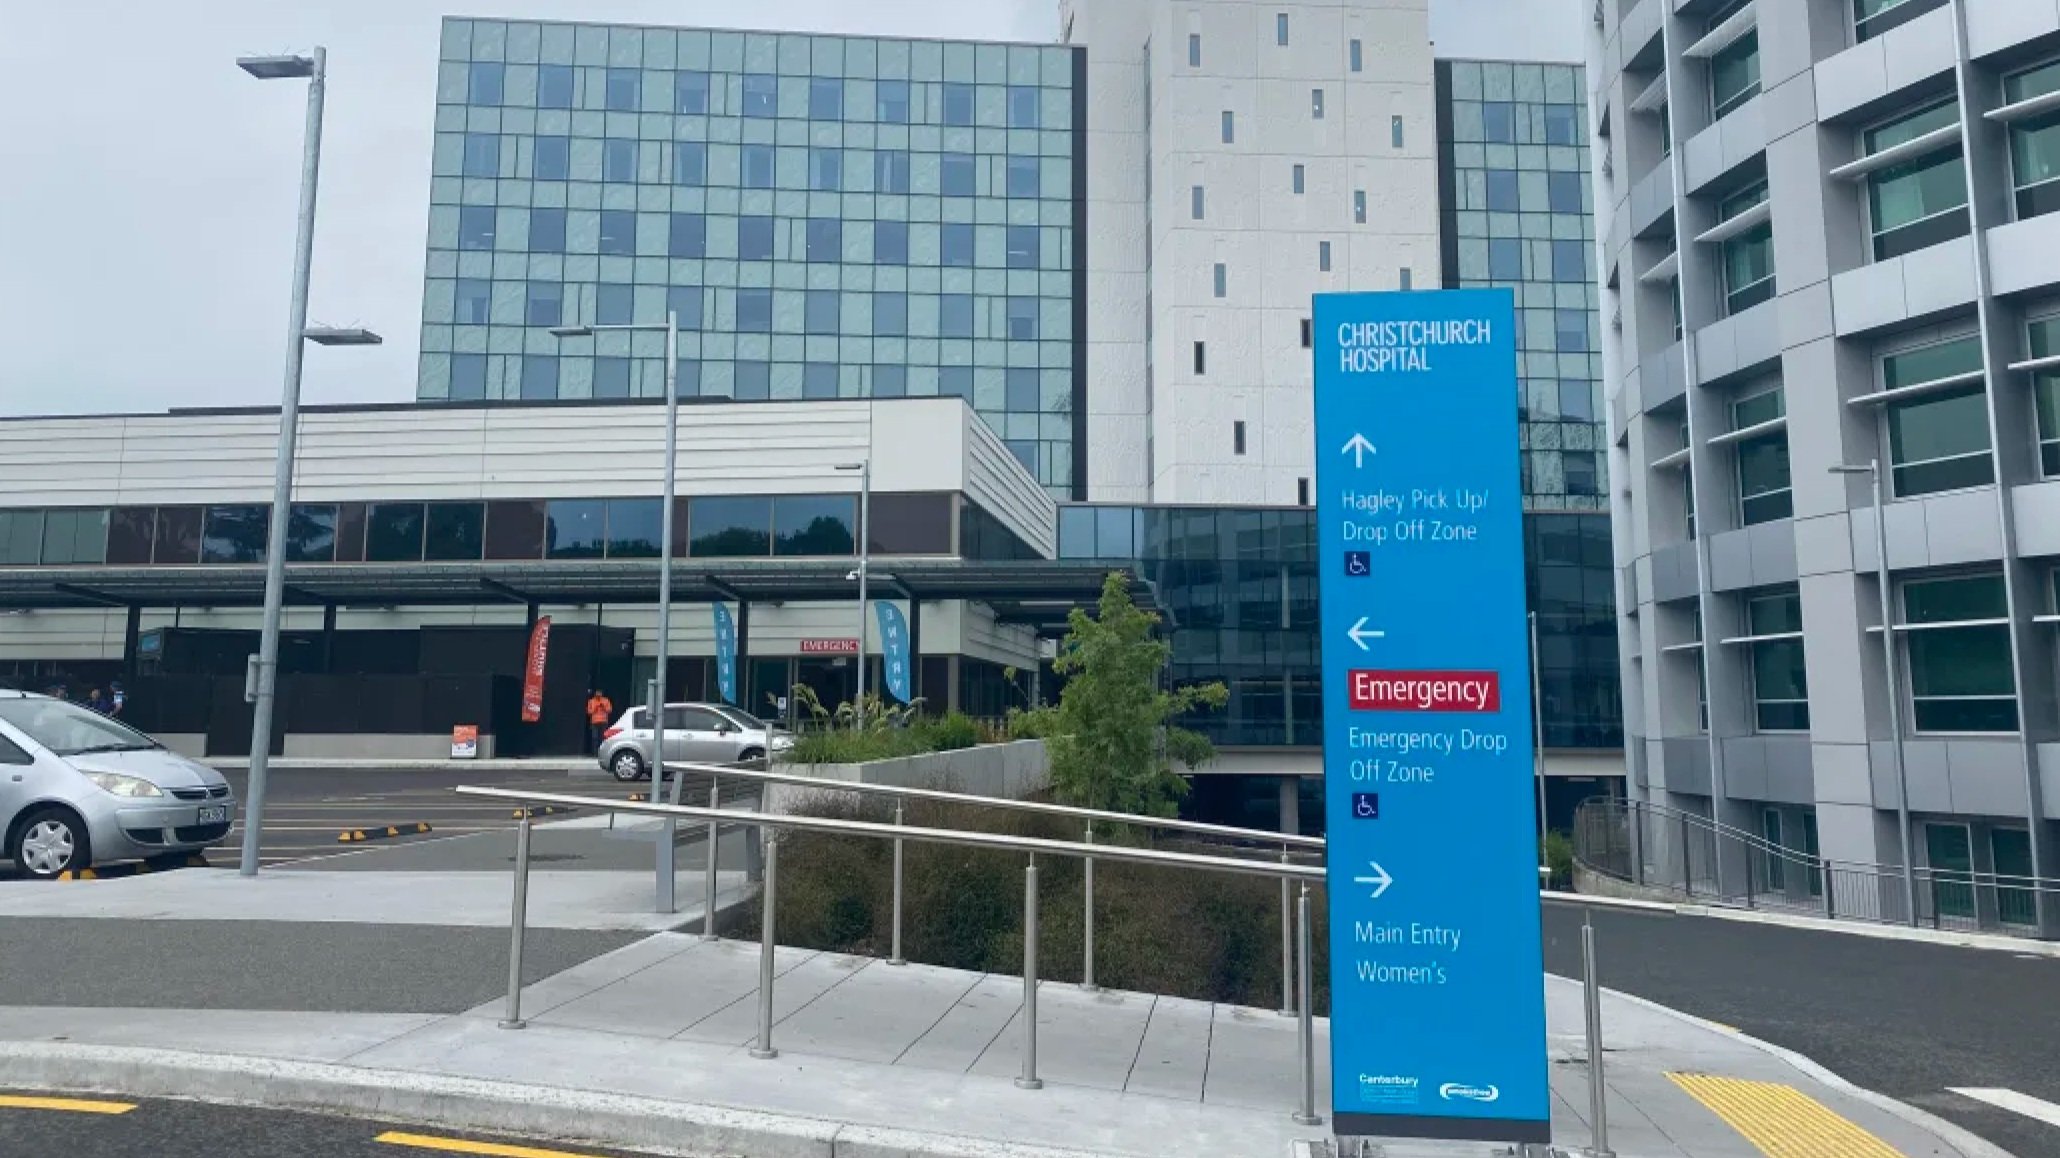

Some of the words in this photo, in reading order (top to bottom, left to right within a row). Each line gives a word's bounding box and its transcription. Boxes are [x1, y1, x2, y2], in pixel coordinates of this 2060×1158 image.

[1337, 319, 1491, 347] CHRISTCHURCH
[1340, 347, 1432, 373] HOSPITAL
[1342, 489, 1404, 515] Hagley
[1411, 489, 1448, 508] Pick
[1456, 489, 1488, 514] Up/
[1343, 520, 1387, 545] Drop
[1395, 519, 1424, 540] Off
[1431, 520, 1477, 540] Zone
[1355, 672, 1489, 710] Emergency
[1349, 726, 1453, 756] Emergency
[1461, 728, 1507, 755] Drop
[1350, 759, 1380, 781] Off
[1387, 760, 1435, 782] Zone
[1355, 920, 1403, 944] Main
[1411, 922, 1461, 951] Entry
[1356, 959, 1447, 984] Women's
[1360, 1072, 1419, 1087] Canterbury
